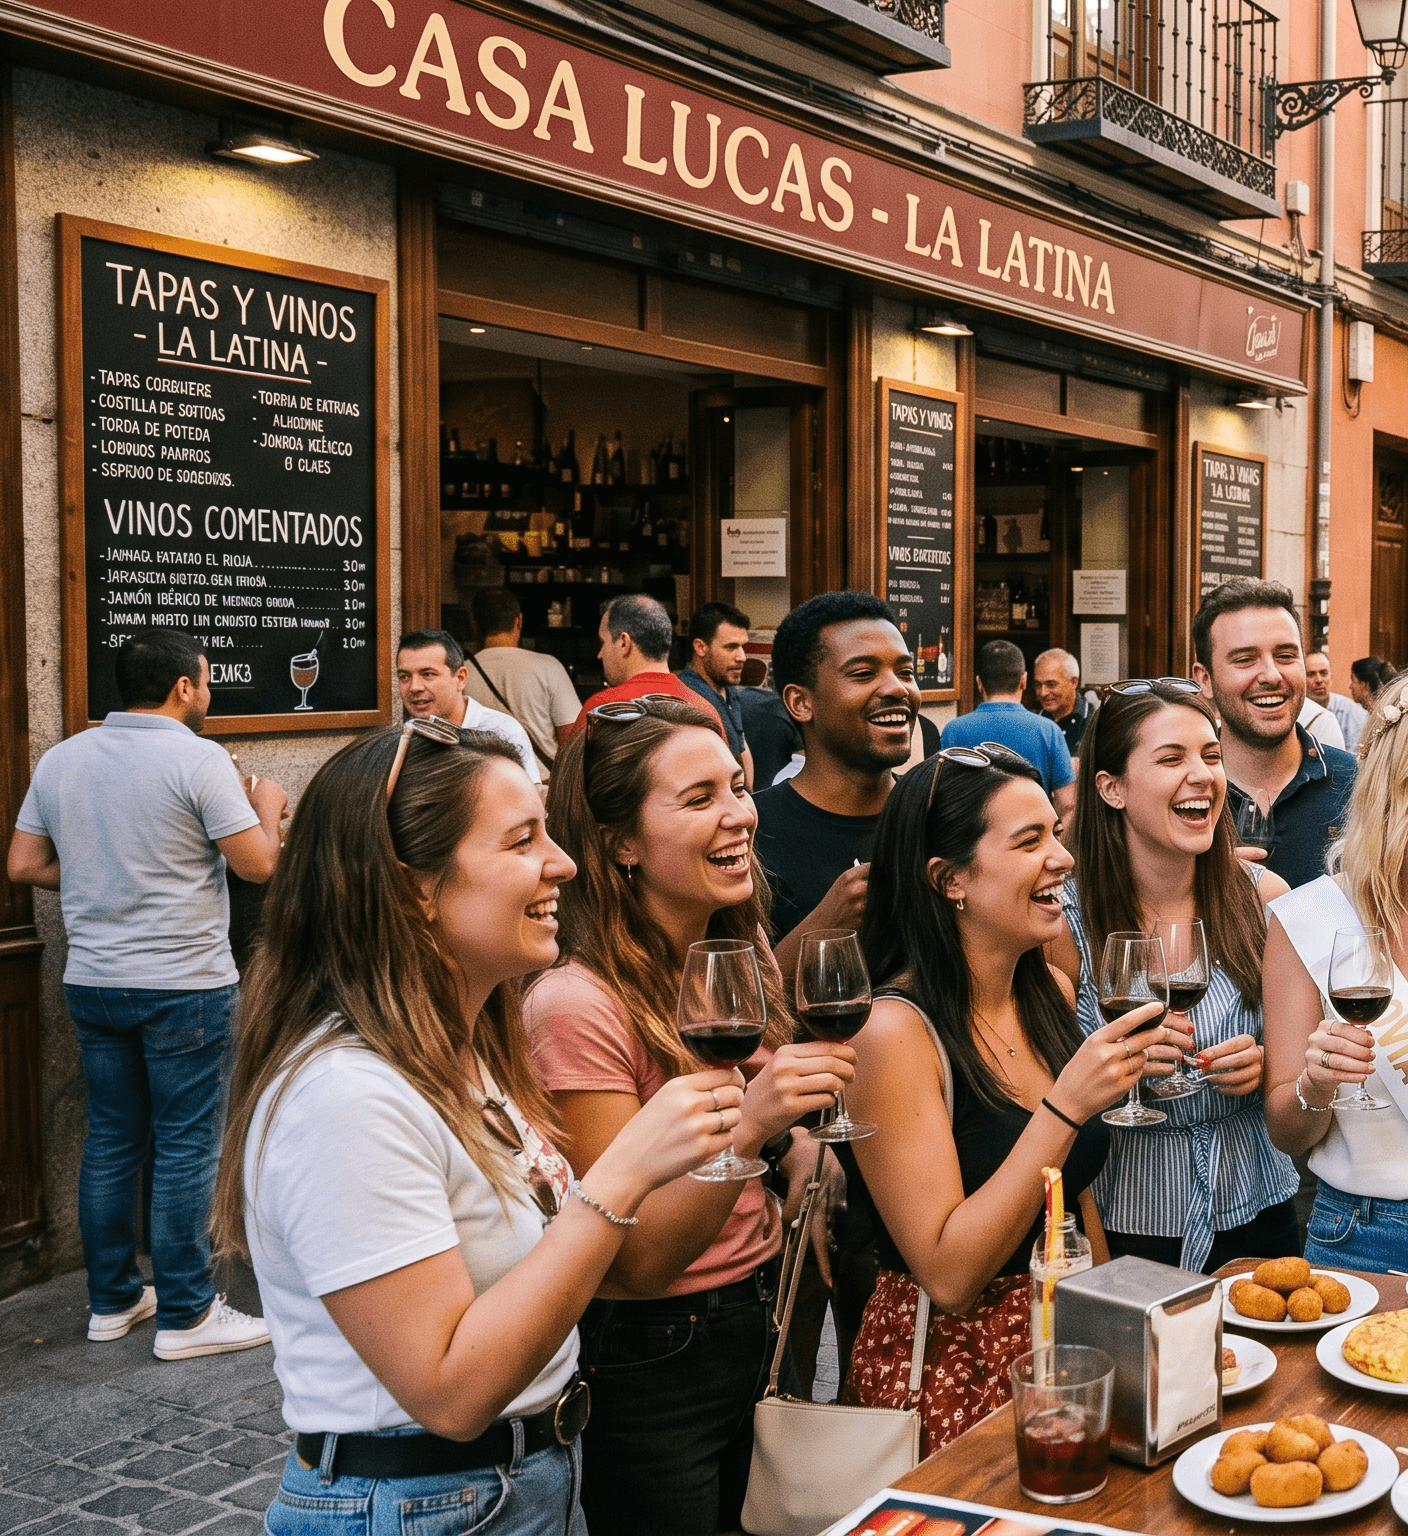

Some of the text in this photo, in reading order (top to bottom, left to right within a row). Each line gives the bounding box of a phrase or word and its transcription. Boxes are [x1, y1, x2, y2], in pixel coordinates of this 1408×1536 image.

[323, 0, 594, 154] CASA
[622, 84, 854, 232] LUCAS
[905, 193, 964, 268] LA
[977, 218, 1116, 314] LATINA
[106, 261, 357, 343] TAPAS Y VINOS
[158, 322, 197, 359] LA
[210, 329, 309, 375] LATINA
[99, 393, 157, 414] COSTILLA
[160, 401, 175, 416] DE
[300, 396, 314, 411] DE
[919, 408, 926, 426] Y
[145, 421, 160, 437] DE
[158, 467, 173, 482] DE
[104, 498, 363, 548] VINOS COMENTADOS
[205, 553, 219, 566] EL
[223, 553, 254, 568] RIOJA
[210, 574, 233, 587] GEN
[204, 593, 219, 607] DE
